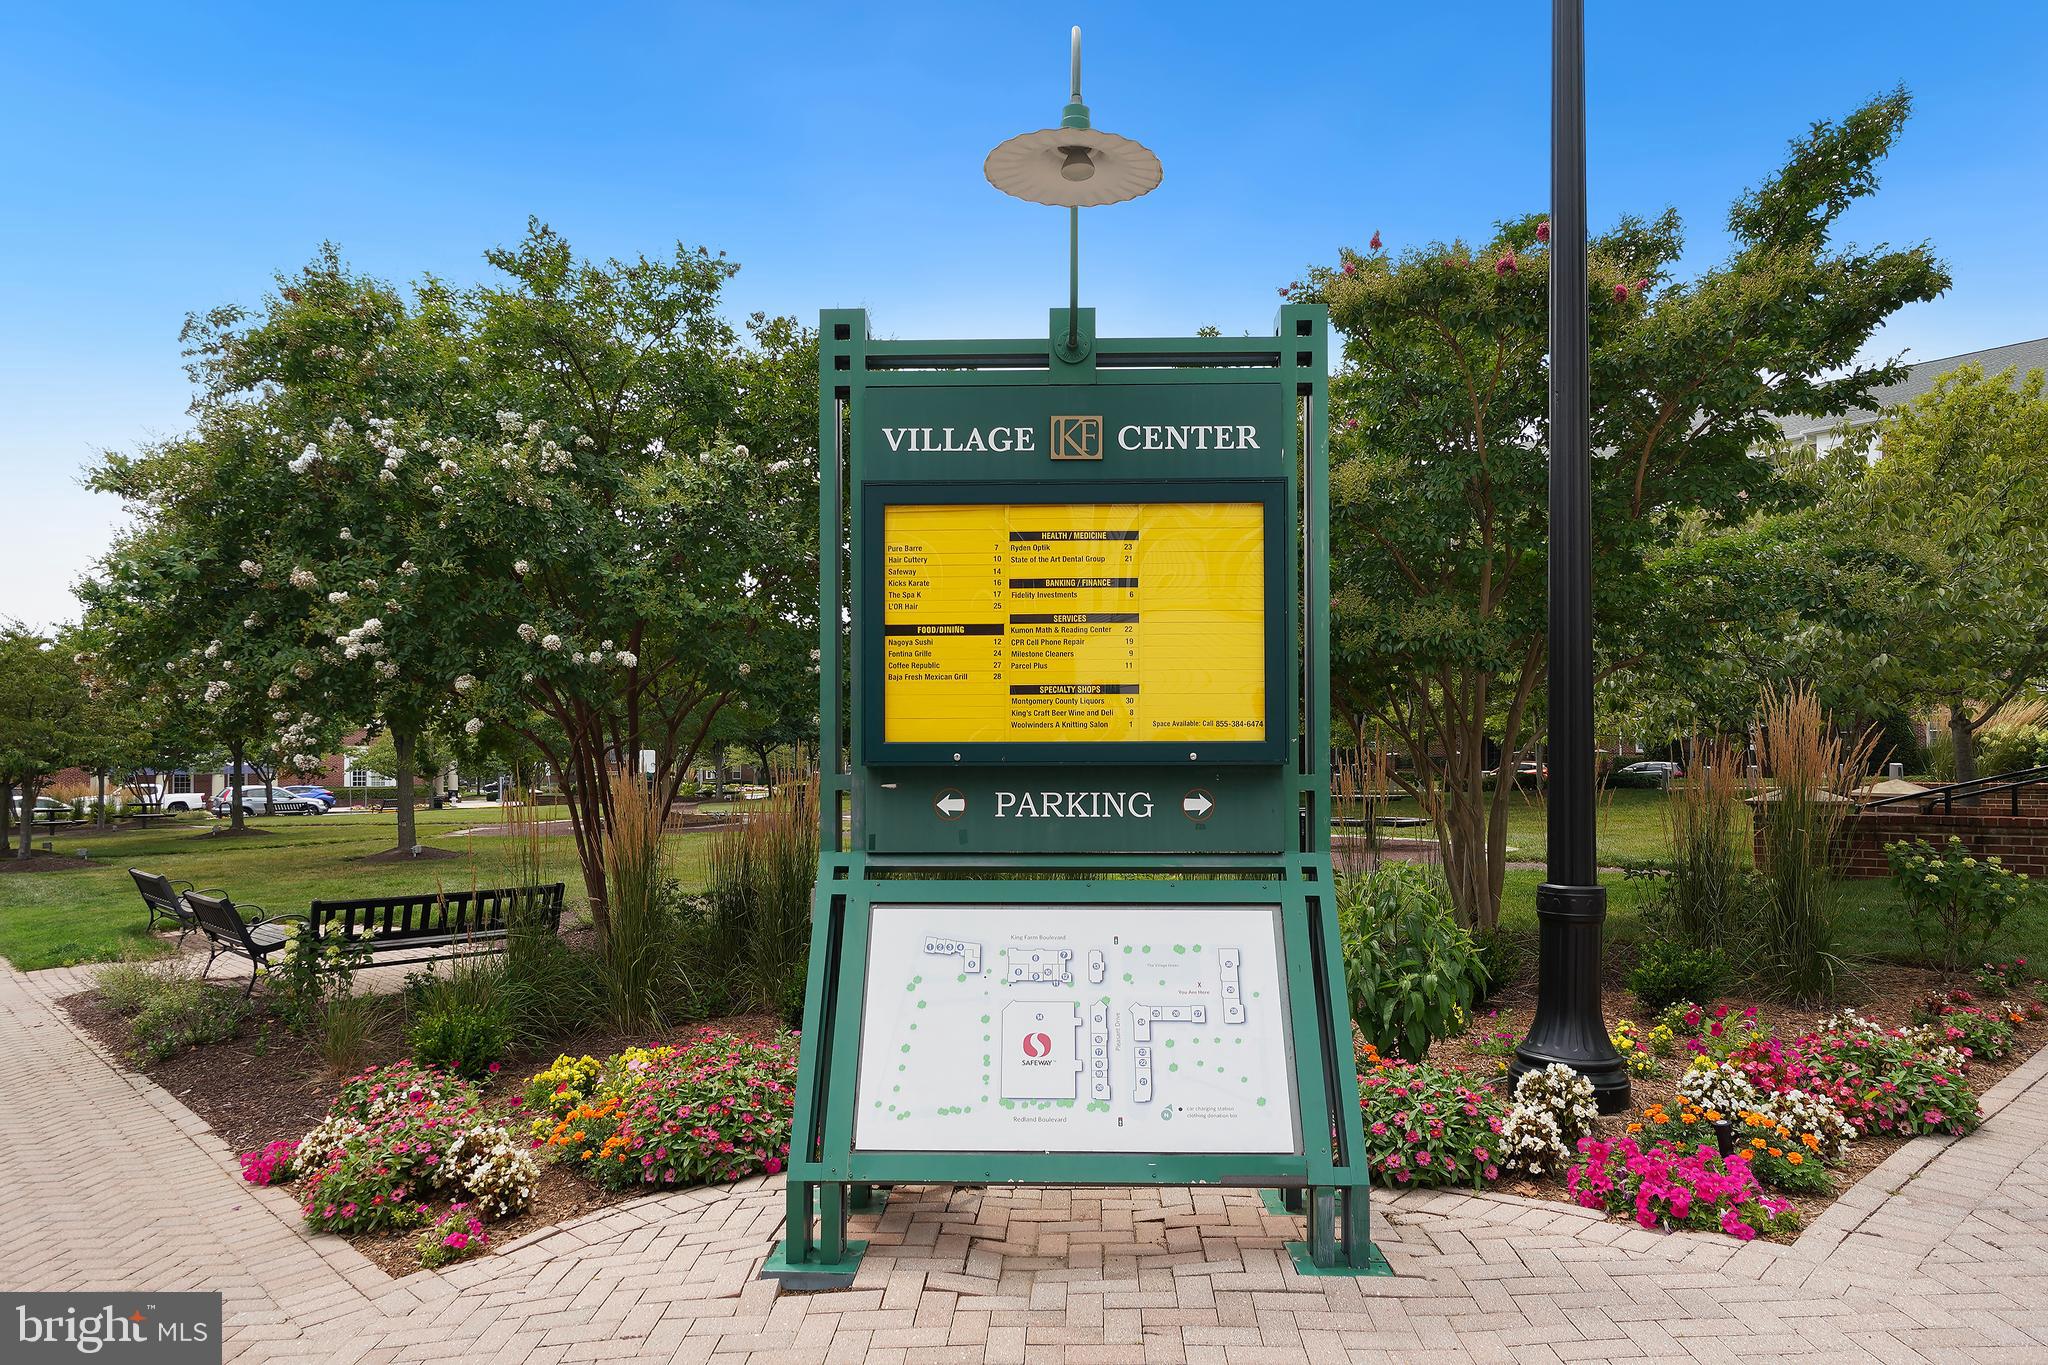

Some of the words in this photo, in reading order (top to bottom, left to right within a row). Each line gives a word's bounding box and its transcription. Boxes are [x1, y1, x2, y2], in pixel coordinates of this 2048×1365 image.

[882, 427, 1035, 452] VILLAGE
[1117, 425, 1260, 452] CENTER
[1068, 532, 1072, 540] /
[1032, 544, 1050, 552] Optik
[1046, 579, 1076, 587] BANKING
[1076, 579, 1080, 587] /
[1053, 614, 1087, 623] SERVICES
[917, 626, 965, 634] FOOD/DINING
[888, 639, 913, 647] Nagoya
[1077, 685, 1101, 693] SHOPS
[994, 792, 1154, 818] PARKING
